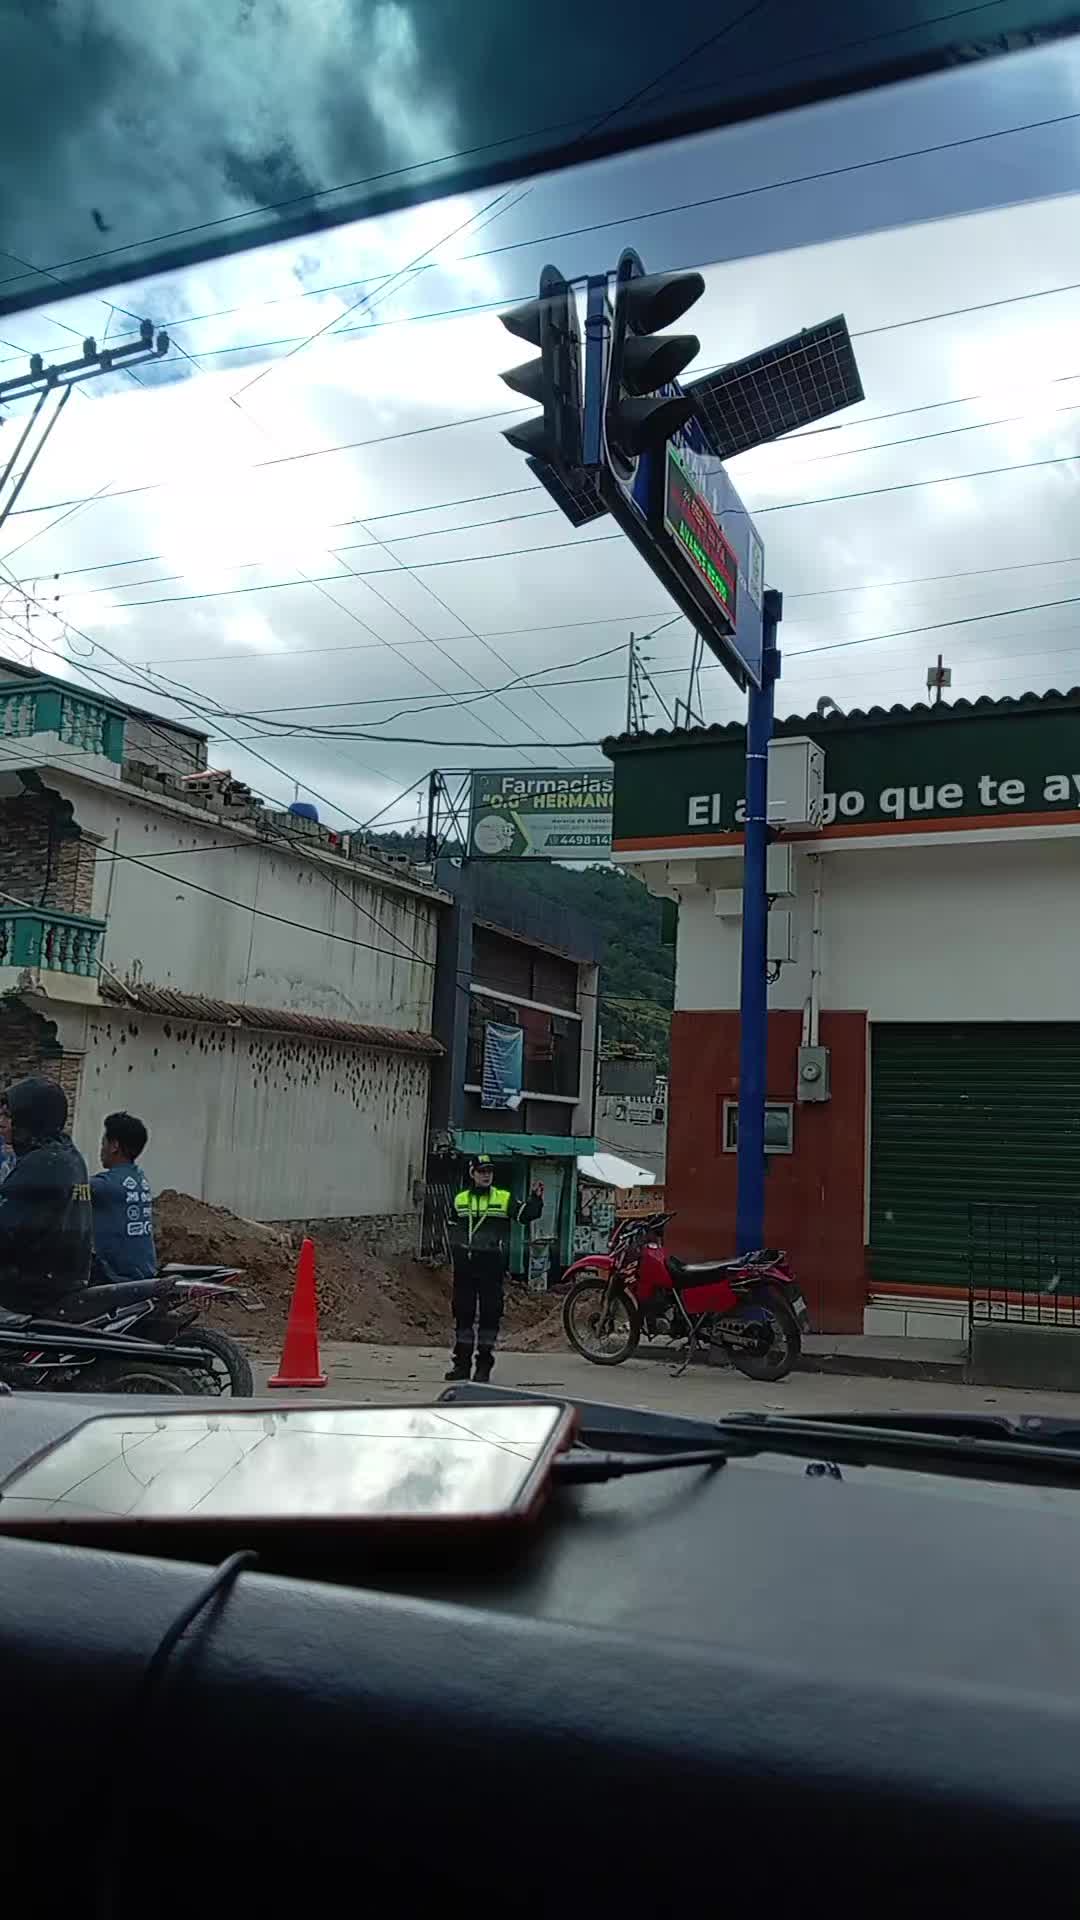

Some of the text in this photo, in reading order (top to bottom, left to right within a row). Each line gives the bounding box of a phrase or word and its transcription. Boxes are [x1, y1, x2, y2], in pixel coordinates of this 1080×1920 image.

[501, 774, 613, 794] Farmacias
[688, 793, 721, 826] El
[734, 791, 865, 825] ago
[880, 783, 964, 819] que
[978, 775, 1025, 807] te
[560, 835, 612, 845] 4498-14
